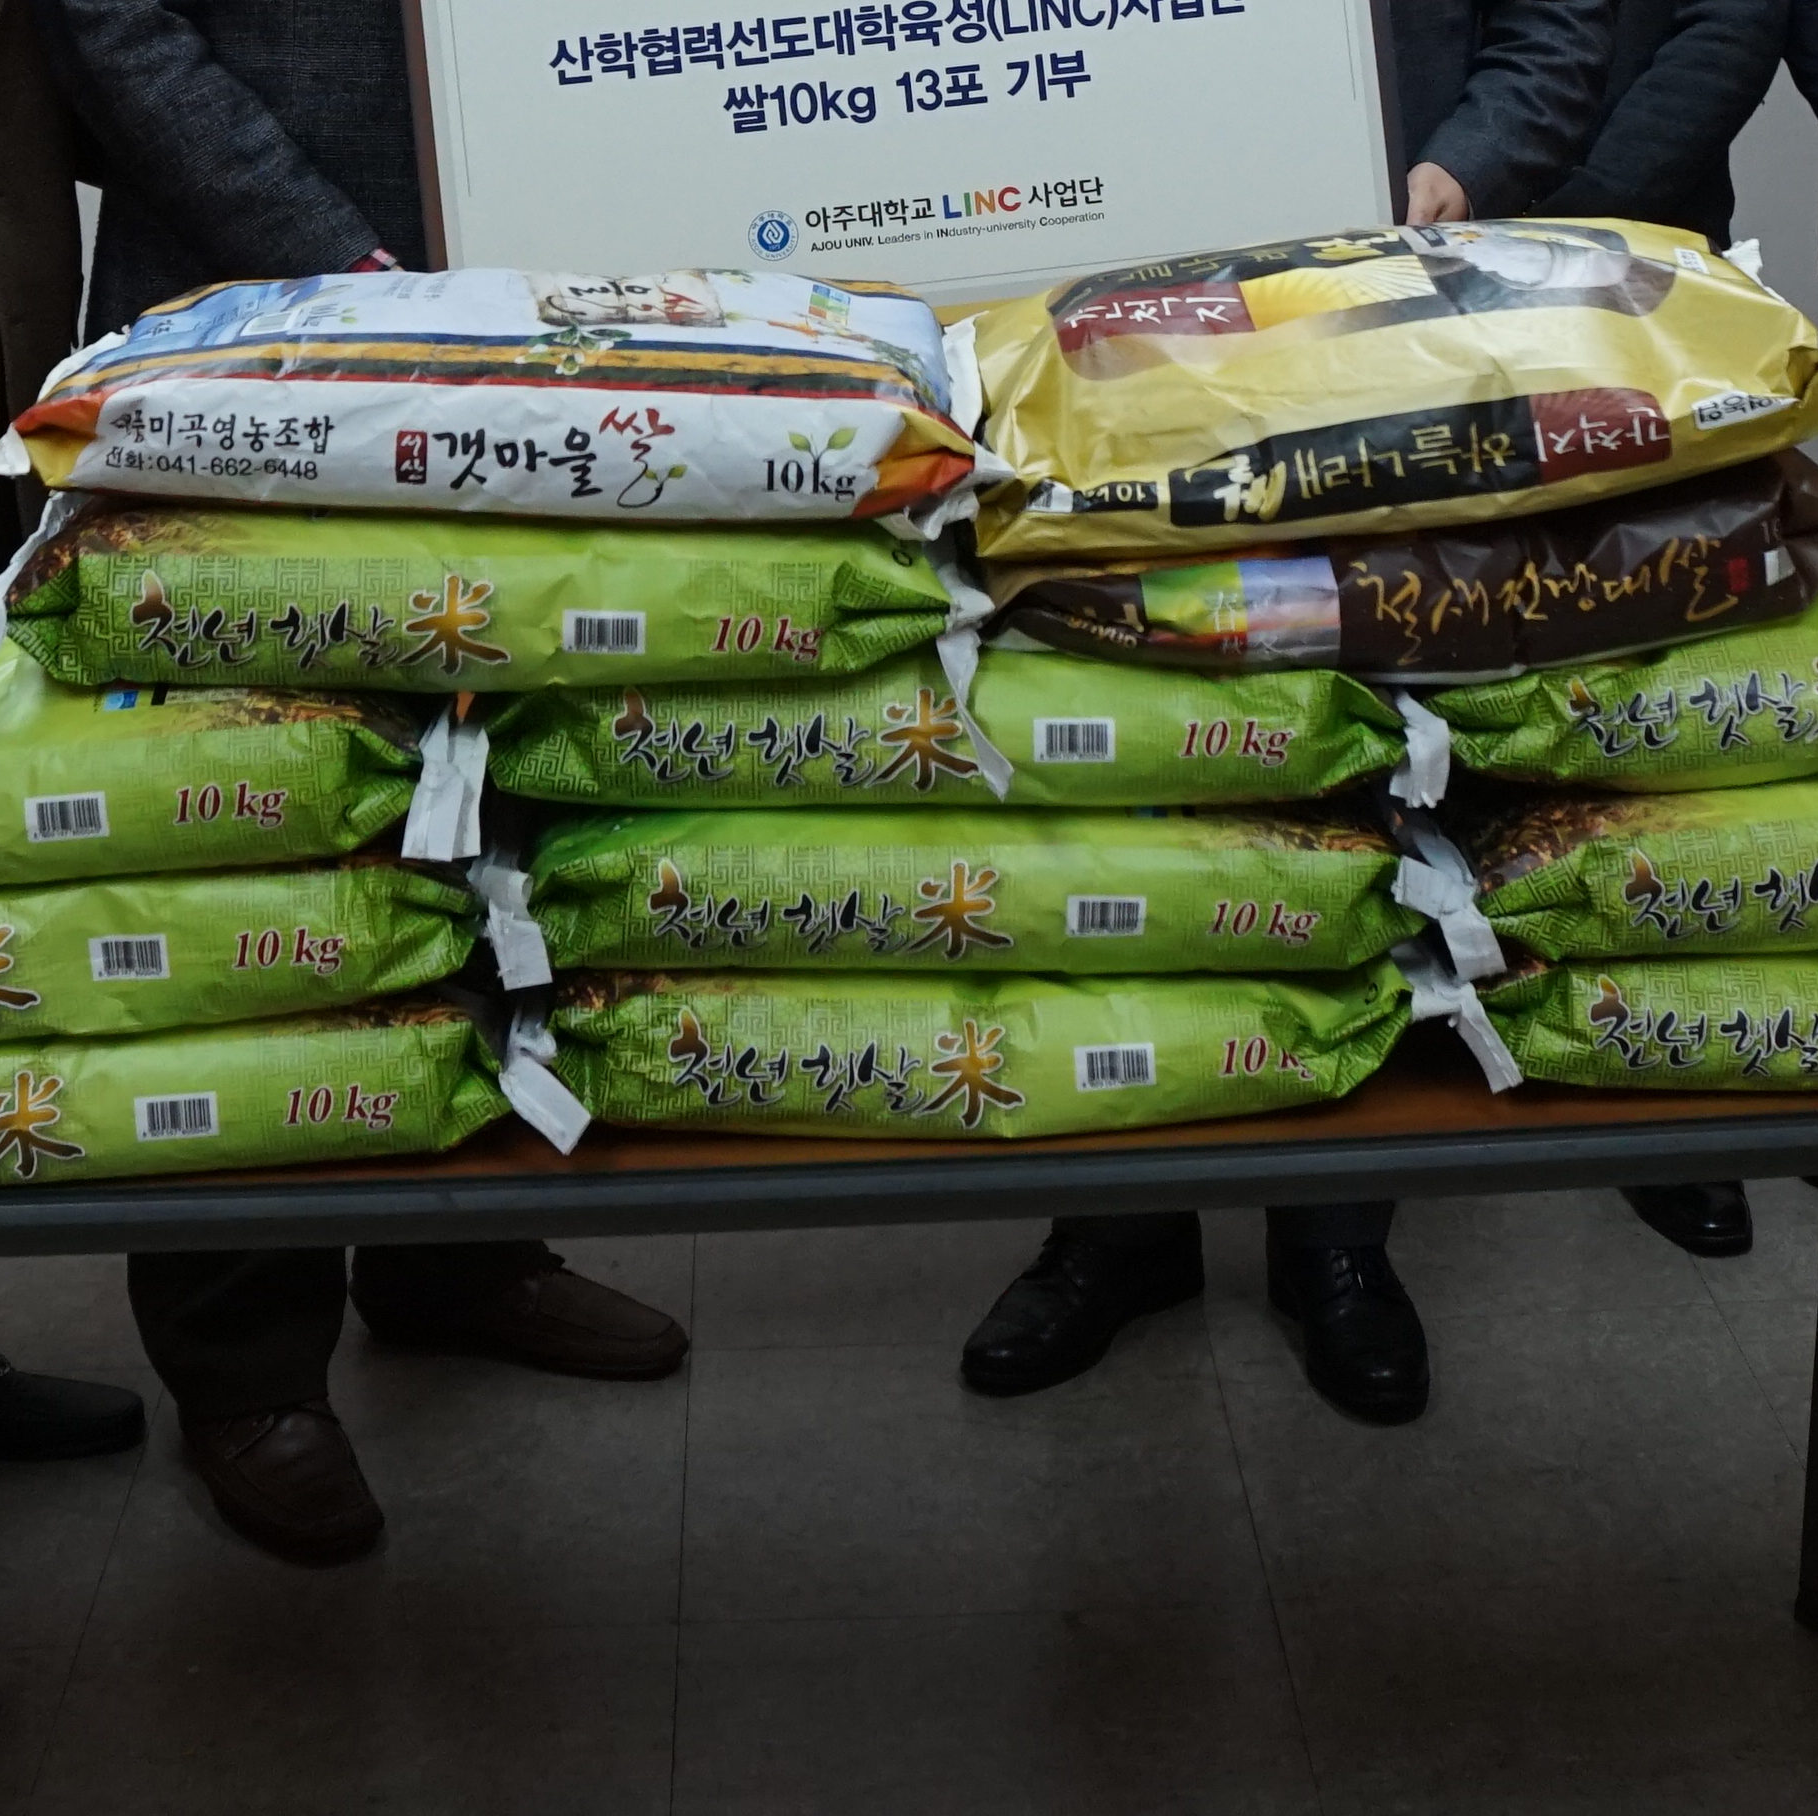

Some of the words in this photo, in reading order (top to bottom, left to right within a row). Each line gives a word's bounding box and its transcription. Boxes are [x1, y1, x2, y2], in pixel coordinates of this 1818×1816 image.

[723, 82, 877, 135] 쌀10kg
[896, 64, 988, 114] 13포
[1006, 50, 1092, 102] 기부
[805, 197, 936, 234] 아주대학교
[942, 186, 1022, 220] LINC
[1028, 176, 1104, 209] 사업단
[810, 239, 842, 253] AJOU
[845, 236, 874, 250] UNIV.
[877, 230, 921, 245] Leaders
[923, 228, 934, 240] in
[936, 218, 1037, 240] INdustry-university
[1039, 211, 1105, 229] Cooperation
[432, 406, 677, 510] 갯마을쌀
[1534, 407, 1672, 464] 간척지
[106, 446, 319, 481] 전화:041-662-6448
[710, 616, 761, 653] 10
[773, 612, 822, 660] kg
[1182, 723, 1231, 759] 10
[1241, 718, 1291, 764] kg
[175, 786, 222, 824] 10
[233, 782, 286, 828] kg
[1210, 902, 1255, 938] 10
[1267, 899, 1318, 944] kg
[234, 932, 280, 970] 10
[292, 926, 343, 973] kg
[1221, 1041, 1268, 1077] 10
[283, 1089, 333, 1126] 10
[344, 1084, 397, 1130] kg
